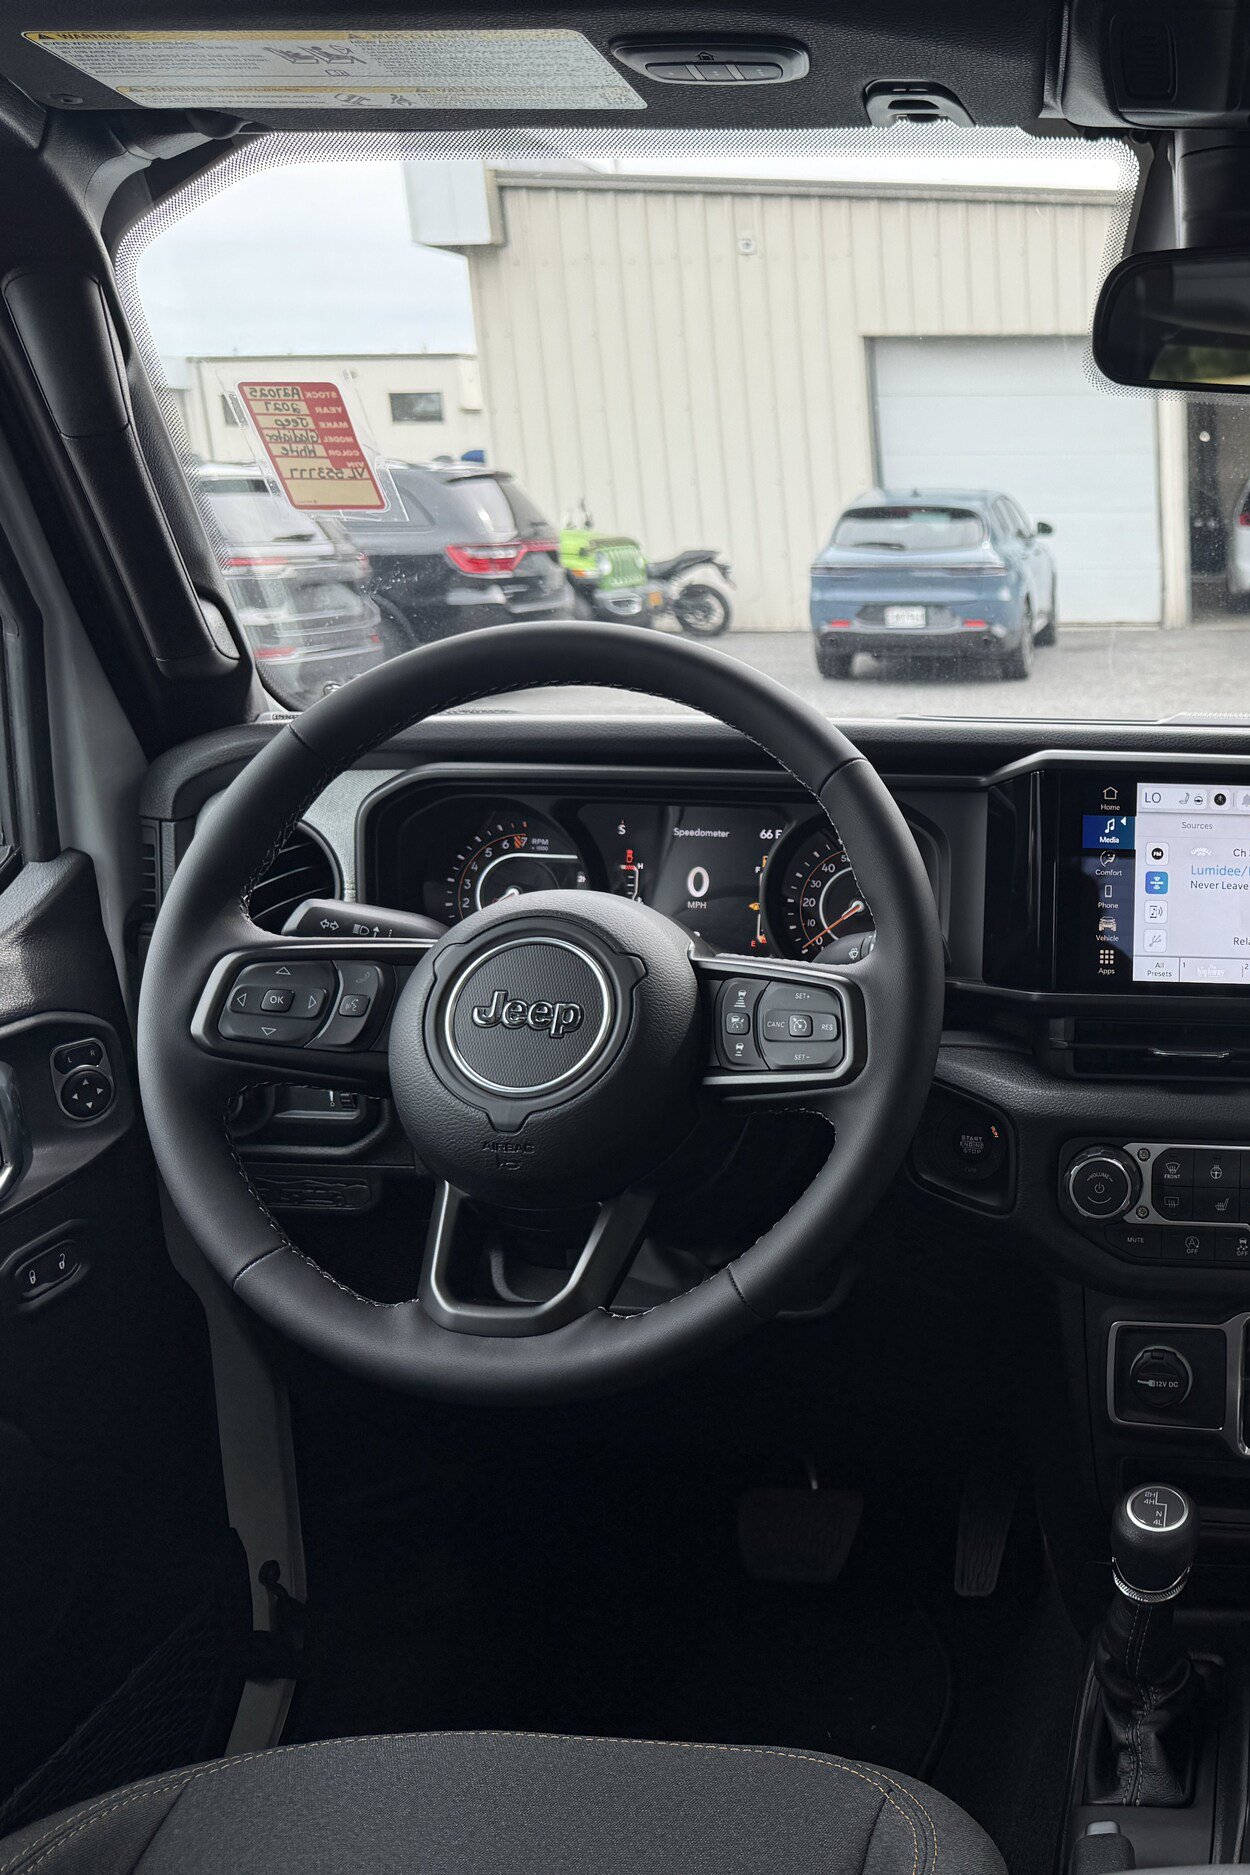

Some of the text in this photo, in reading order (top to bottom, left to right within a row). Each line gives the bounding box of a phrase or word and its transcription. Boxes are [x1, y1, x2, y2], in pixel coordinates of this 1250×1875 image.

[1144, 792, 1162, 804] LO
[618, 825, 626, 835] S
[1181, 821, 1213, 831] Sources
[673, 827, 730, 838] Speedometer
[760, 829, 782, 839] 66 F
[501, 840, 510, 850] 6
[521, 836, 528, 848] 7
[1099, 836, 1120, 844] Media
[485, 847, 493, 858] 5
[1233, 848, 1247, 858] Ch
[471, 862, 478, 872] 4
[821, 864, 836, 873] 40
[1095, 869, 1122, 877] Comfort
[464, 879, 471, 889] 3
[686, 866, 710, 898] 0
[810, 880, 822, 888] 30
[1190, 880, 1219, 890] Never
[1221, 881, 1249, 891] Leave
[462, 898, 470, 908] 2
[687, 901, 707, 909] MPH
[802, 897, 816, 908] 20
[807, 919, 816, 928] 10
[816, 936, 823, 945] 0
[1096, 934, 1119, 942] Vehicle
[1098, 967, 1115, 975] Apps
[1147, 969, 1173, 979] Presets
[270, 995, 284, 1004] OK
[472, 990, 584, 1038] Jeep
[1127, 1236, 1144, 1244] MUTE
